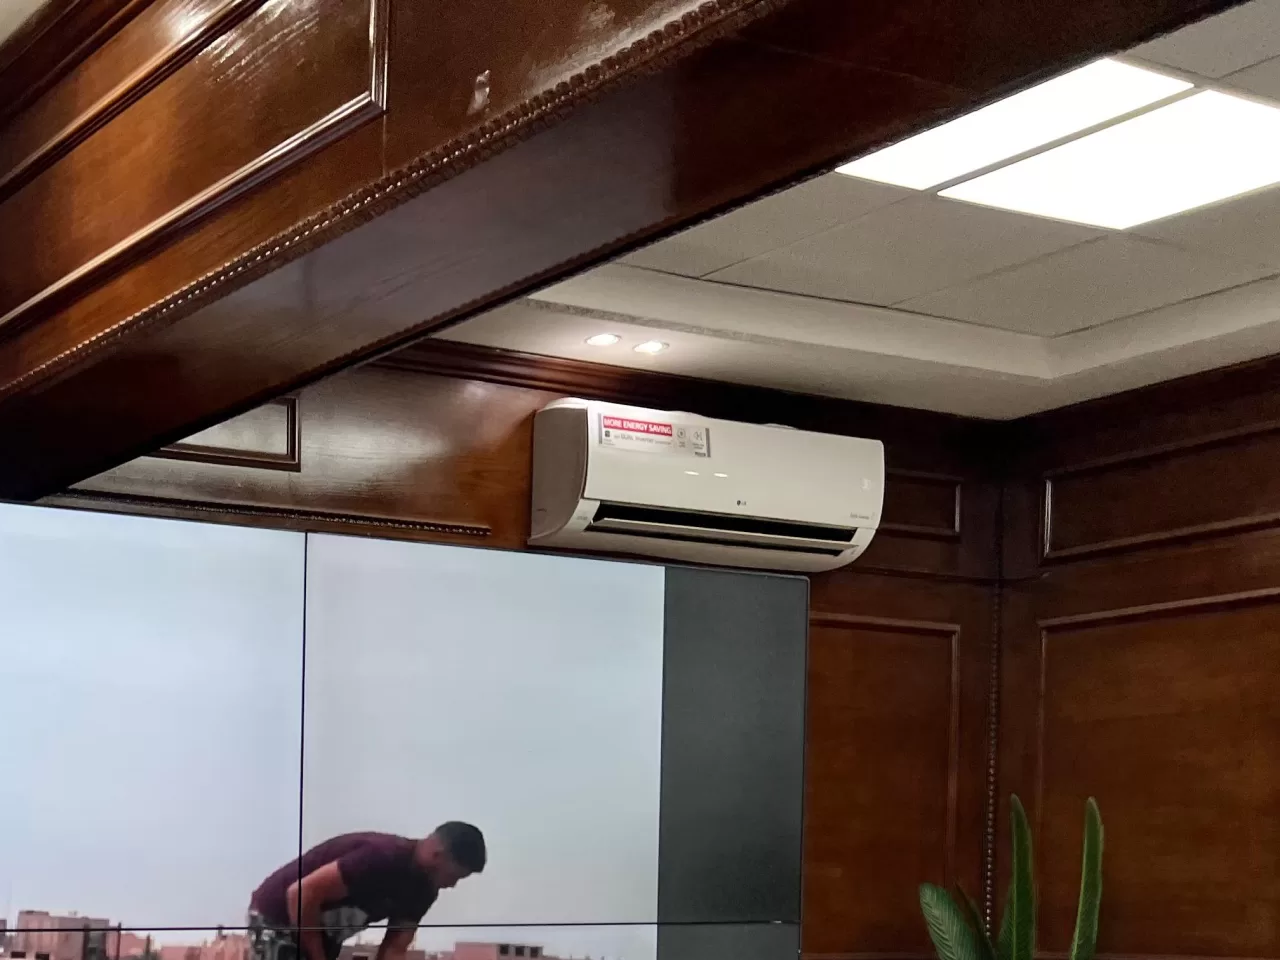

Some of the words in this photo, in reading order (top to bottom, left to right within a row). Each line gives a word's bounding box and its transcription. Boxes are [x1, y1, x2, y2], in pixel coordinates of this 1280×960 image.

[604, 418, 622, 428] MORE
[623, 420, 648, 432] ENERGY
[648, 424, 672, 435] SAVING
